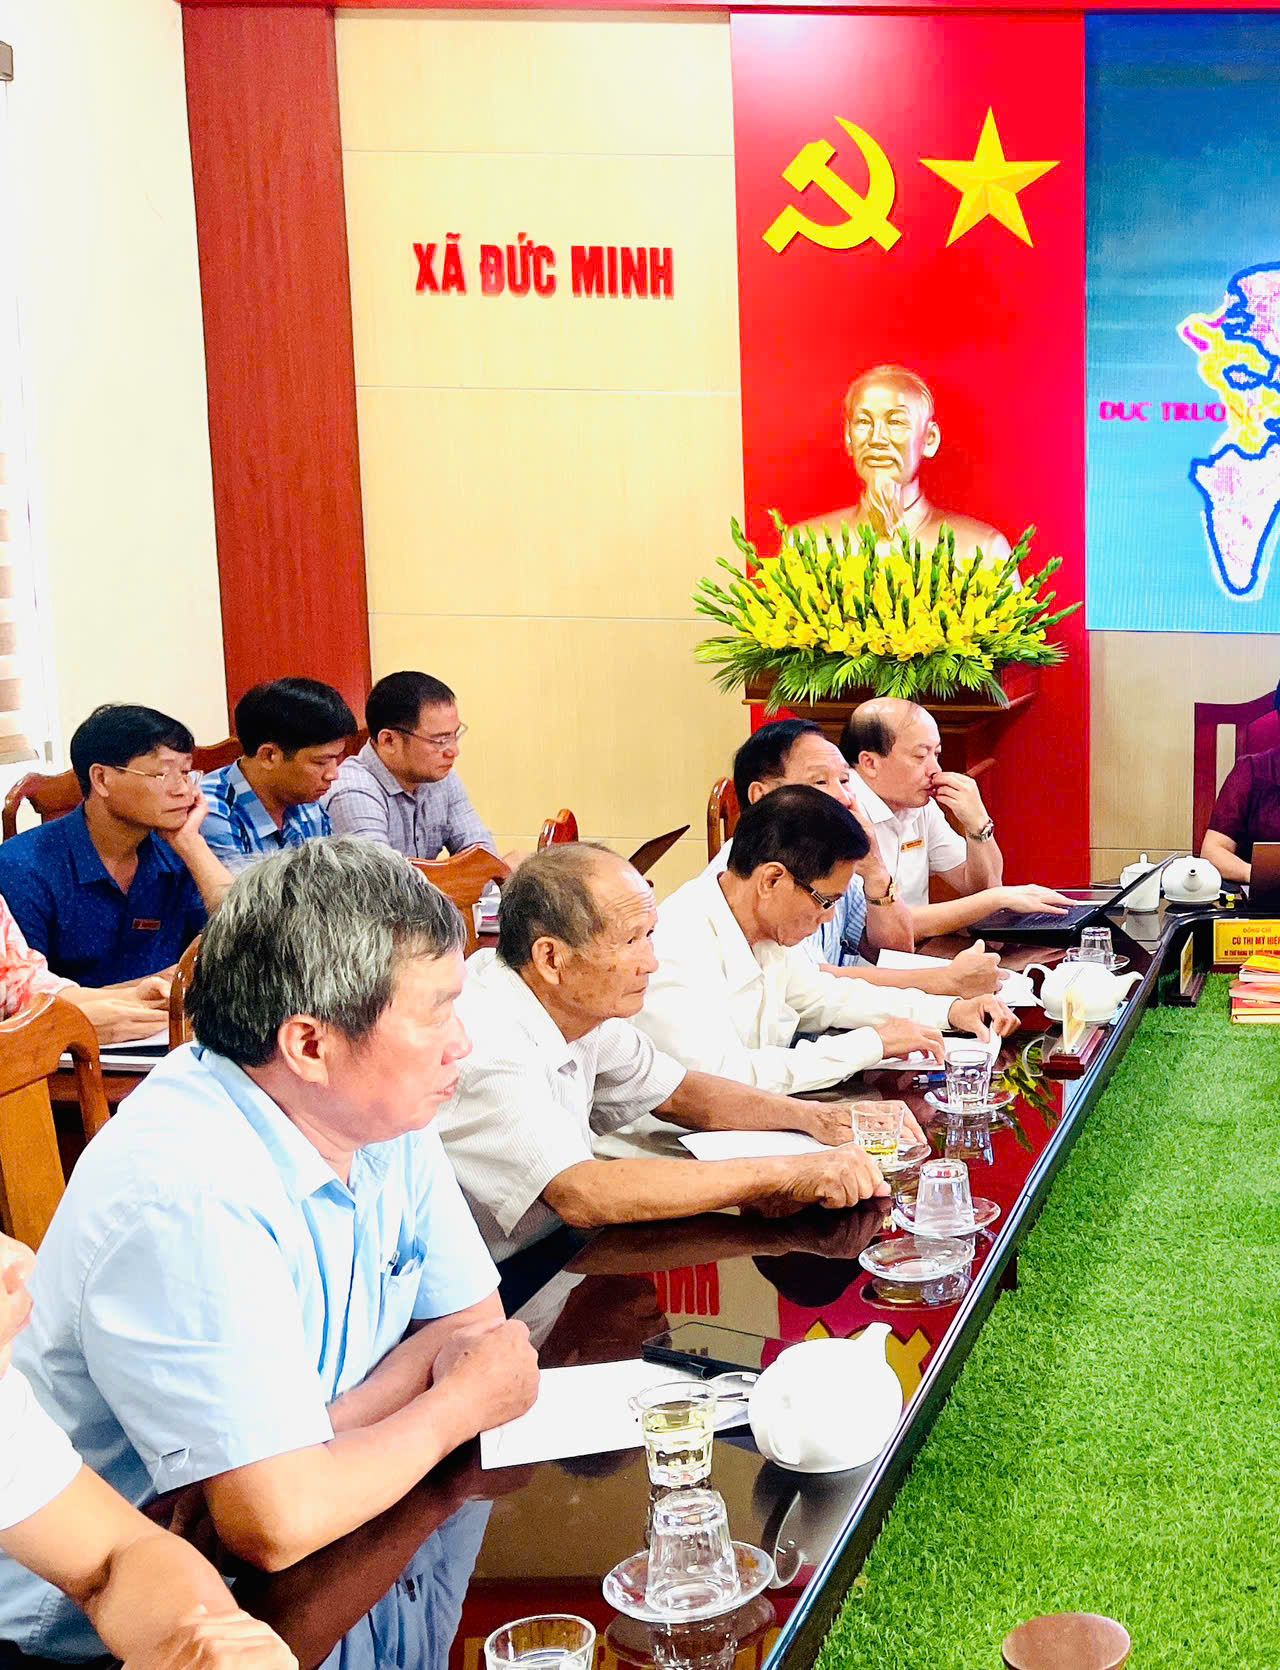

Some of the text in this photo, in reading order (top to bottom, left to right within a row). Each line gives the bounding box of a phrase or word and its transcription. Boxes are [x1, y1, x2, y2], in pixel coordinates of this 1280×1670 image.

[412, 232, 674, 299] XÃ ĐỨC MINH
[1098, 401, 1153, 423] DUC
